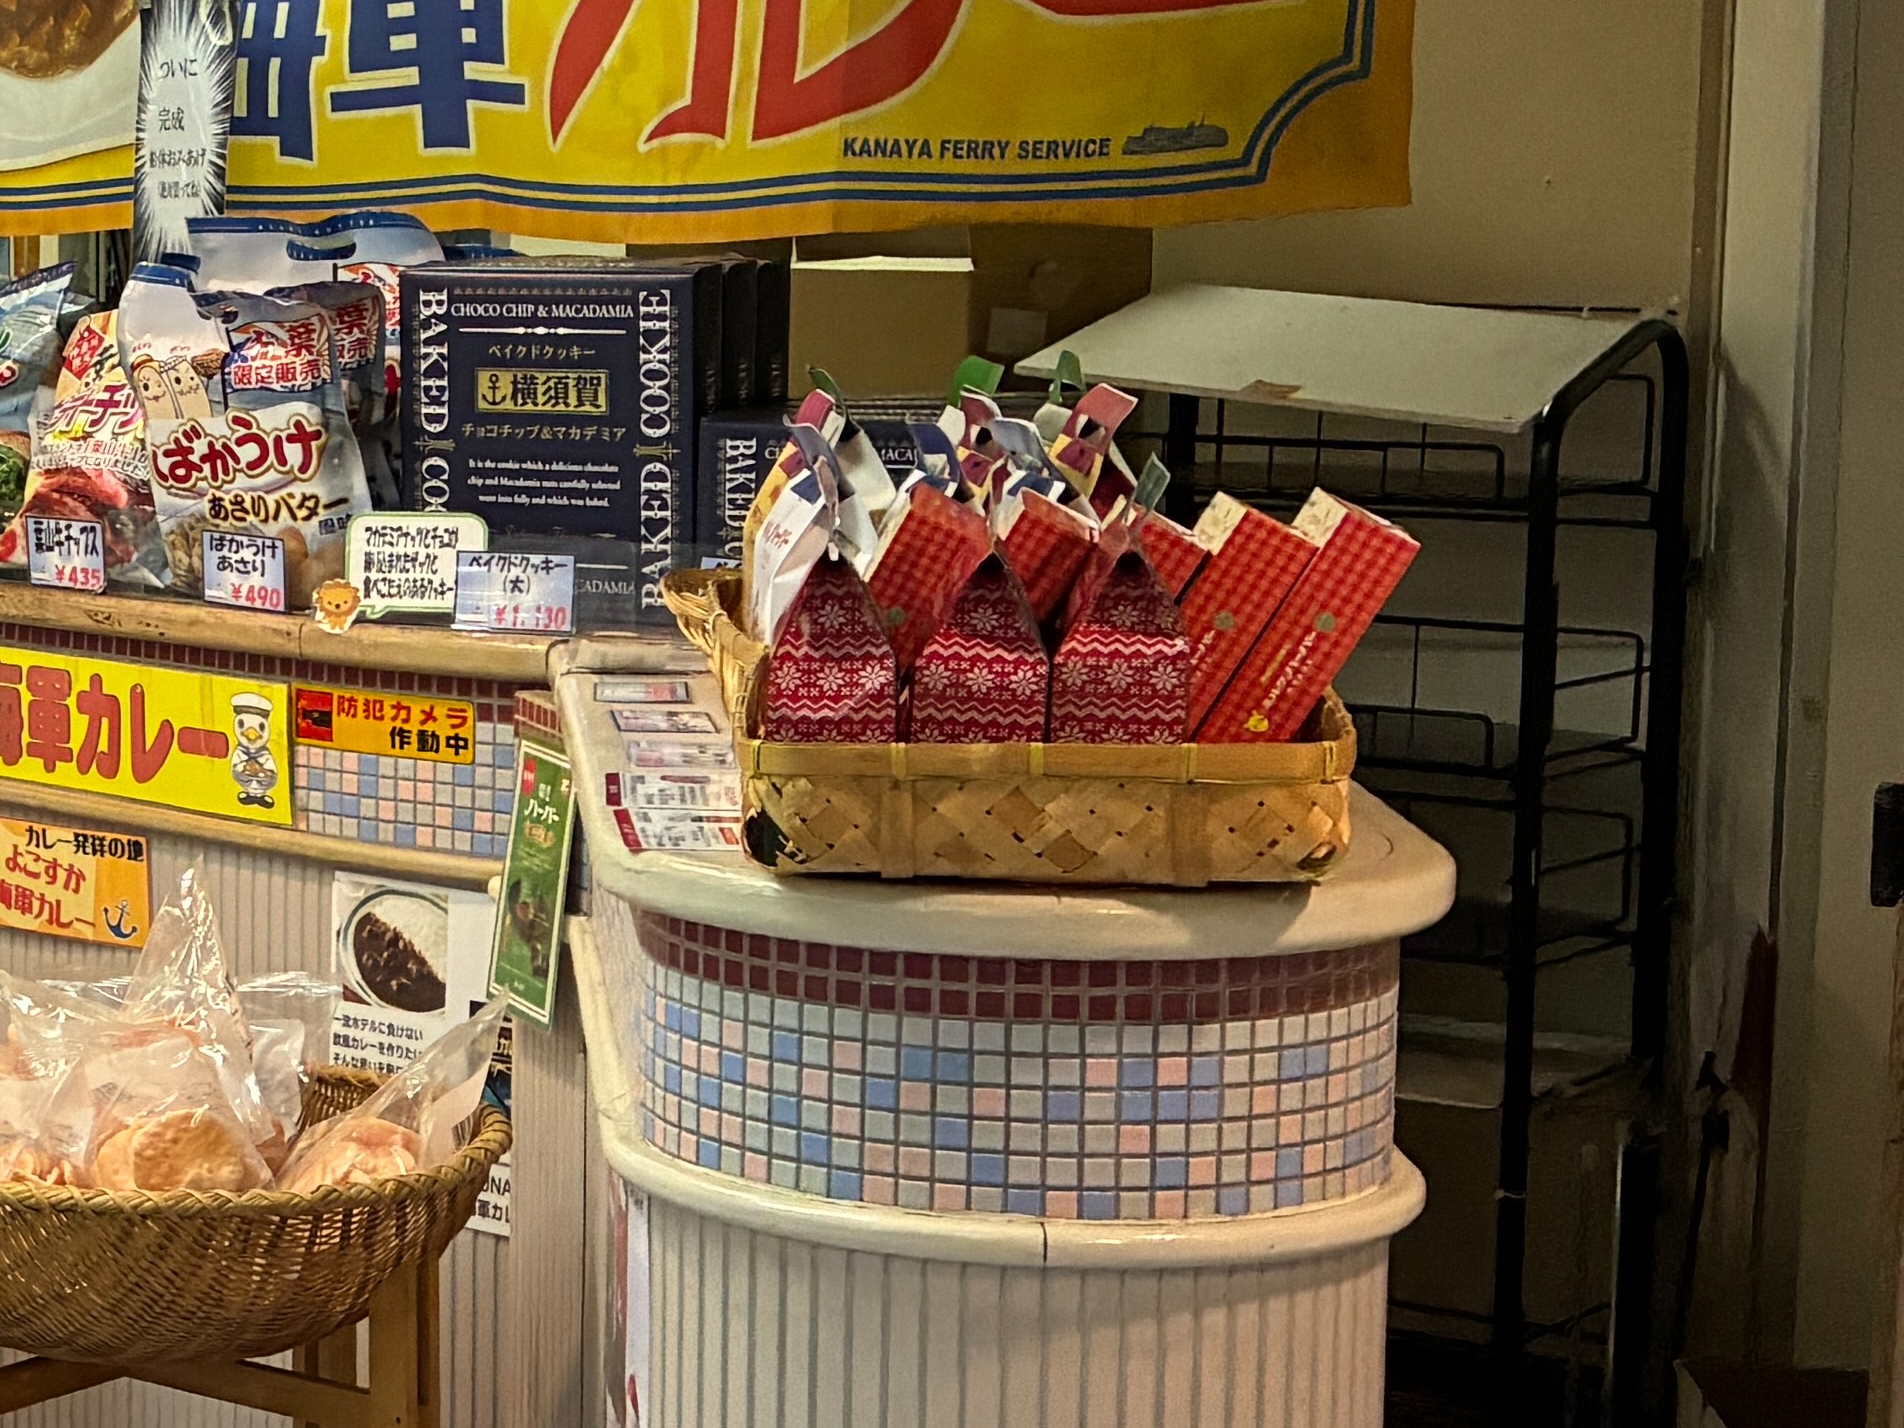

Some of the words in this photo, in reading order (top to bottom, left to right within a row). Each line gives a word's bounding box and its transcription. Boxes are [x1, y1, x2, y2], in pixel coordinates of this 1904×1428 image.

[158, 58, 199, 80] ついに
[157, 107, 185, 132] 完成
[842, 137, 934, 161] KANAYA
[939, 137, 1011, 161] FERRY
[1016, 135, 1112, 160] SERVICE
[450, 303, 501, 318] CHOCO
[502, 303, 535, 318] CHIP
[536, 305, 549, 318] &
[551, 303, 635, 319] MACADAMIA
[419, 286, 450, 434] BAKED
[488, 344, 596, 360] ベイクドクッキー
[639, 288, 671, 439] COOKIE
[232, 361, 322, 387] 限定販売
[509, 373, 602, 410] 横須賀
[461, 423, 628, 441] チョコチップ&マカデミア
[151, 416, 324, 485] ばかうけ
[207, 492, 350, 524] あさりバター
[209, 534, 279, 560] ばかうけ
[55, 564, 103, 589] ¥435
[216, 554, 267, 578] あさり
[468, 554, 568, 576] ベイクドクッキー
[230, 582, 282, 610] ¥490
[502, 574, 531, 596] (大)
[336, 693, 470, 729] 防犯カメラ
[389, 726, 470, 756] 作動中
[25, 825, 145, 862] カレー発祥の地
[5, 843, 87, 895] よこすか
